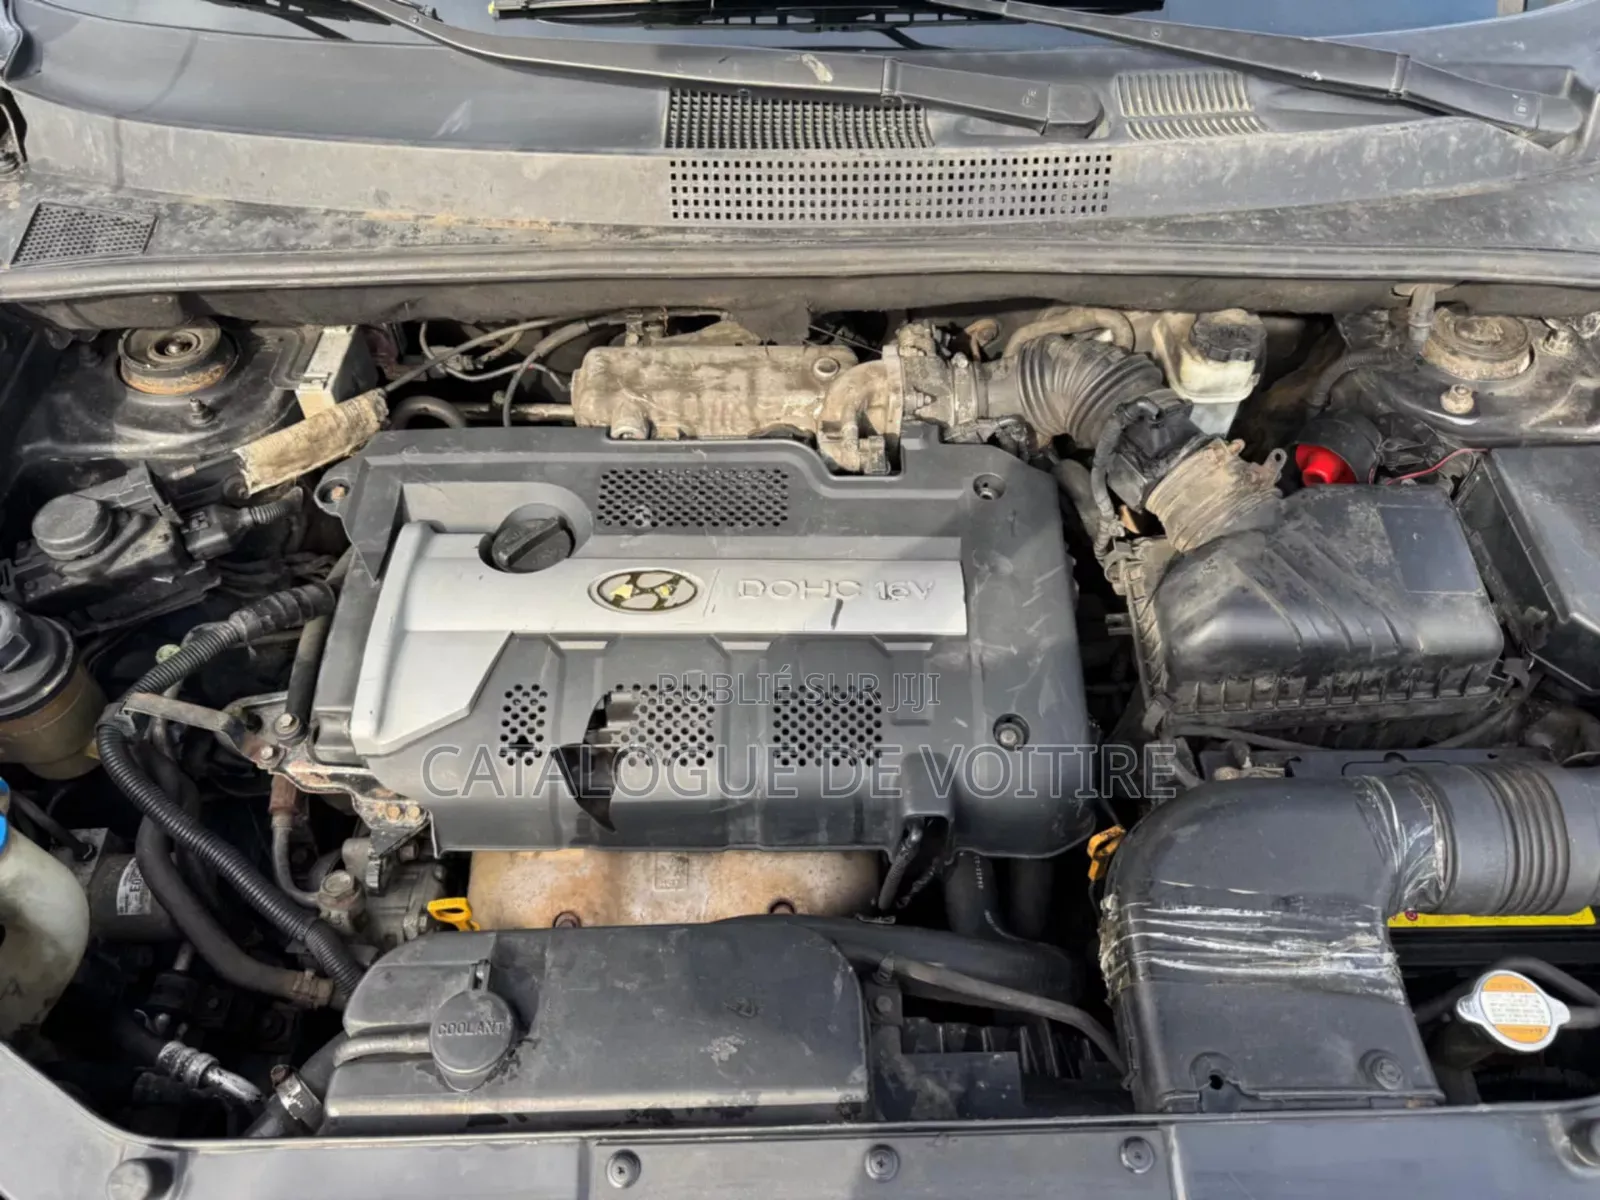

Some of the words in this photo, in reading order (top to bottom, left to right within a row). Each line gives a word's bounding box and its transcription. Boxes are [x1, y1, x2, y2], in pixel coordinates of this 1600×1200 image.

[739, 579, 861, 600] DOHC
[875, 580, 935, 601] 16V
[437, 1020, 504, 1037] COOLANT
